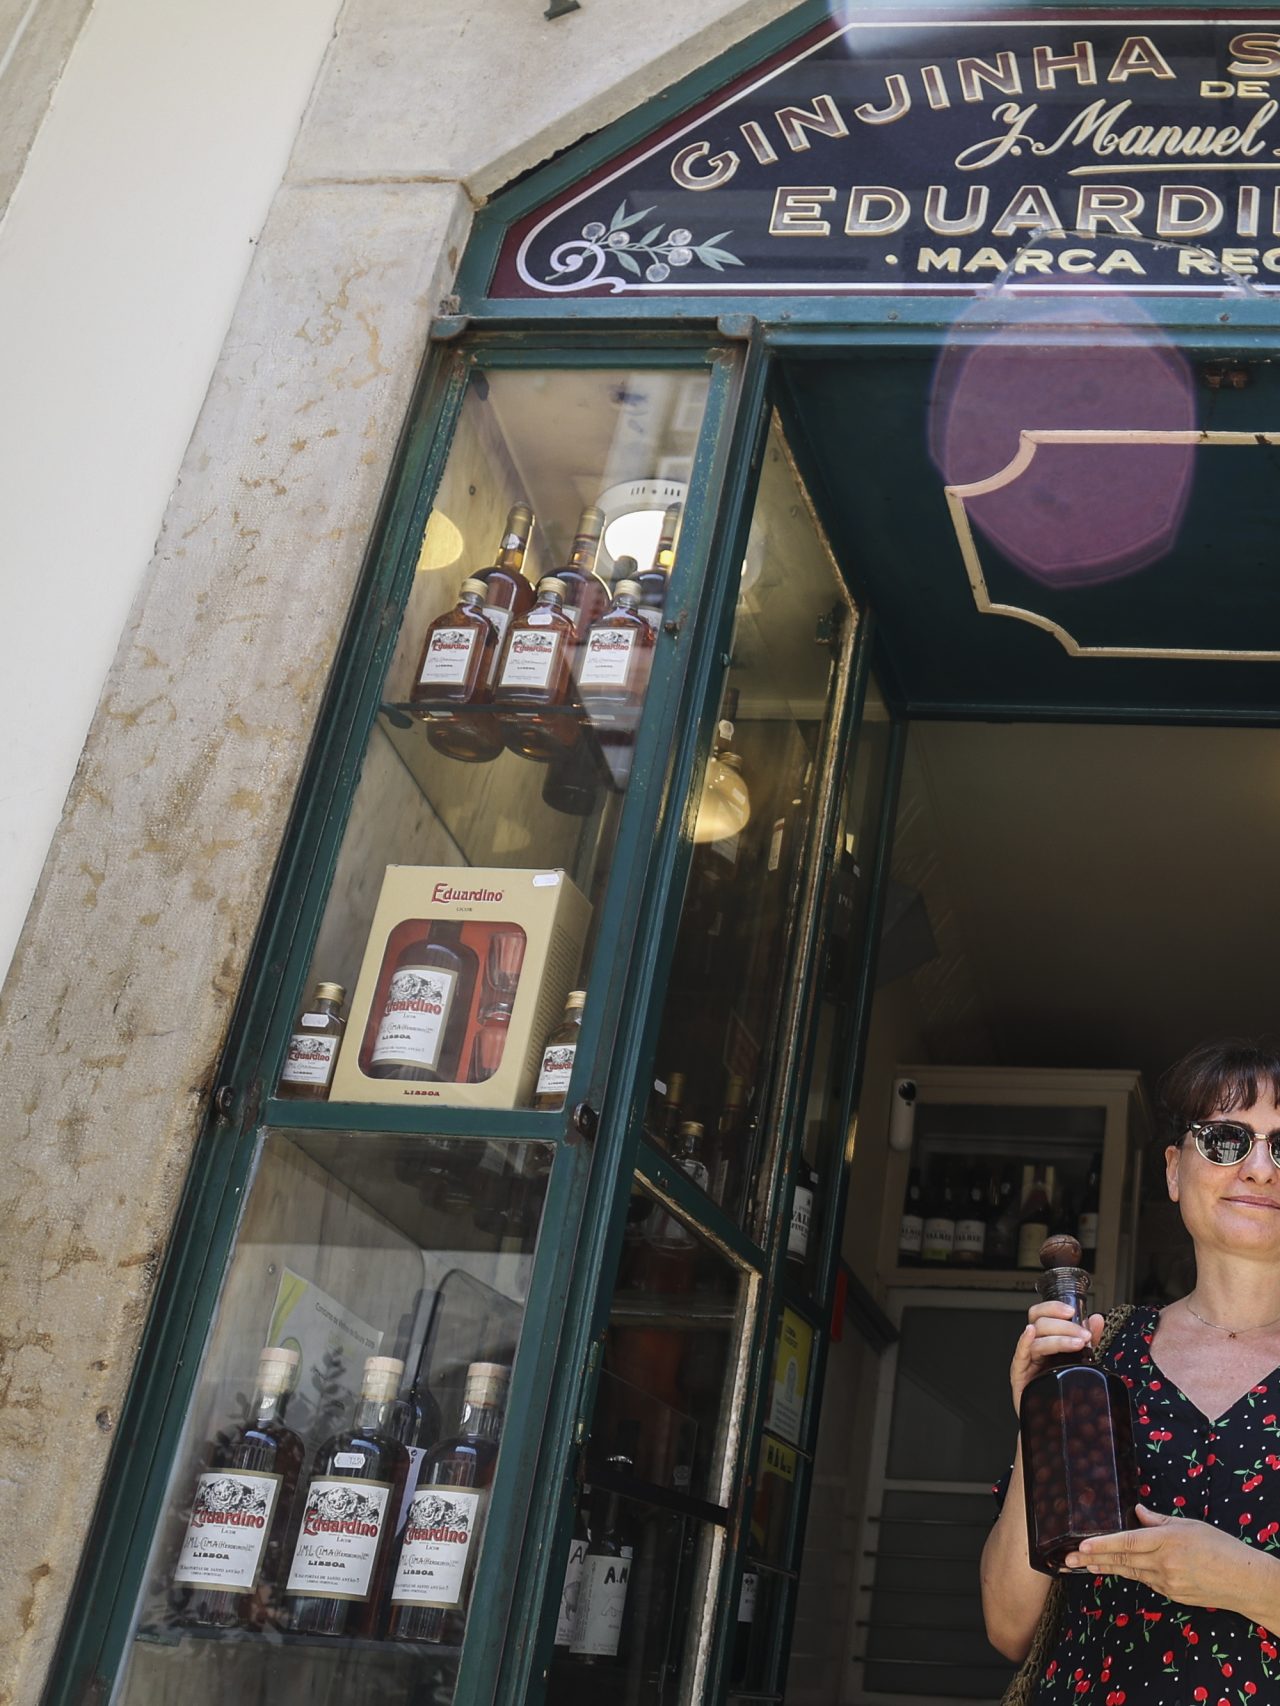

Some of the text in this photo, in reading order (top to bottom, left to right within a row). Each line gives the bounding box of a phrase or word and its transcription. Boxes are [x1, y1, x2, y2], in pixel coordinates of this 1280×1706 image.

[1200, 81, 1270, 99] DE
[670, 35, 1177, 191] GINJINHA
[1033, 98, 1268, 158] Manuel
[916, 247, 1151, 276] MARCA
[431, 882, 504, 904] Eduardino
[190, 1502, 266, 1528] Eduardino
[303, 1508, 378, 1537] Eduardino
[193, 1552, 230, 1560] LISBOA
[308, 1560, 346, 1569] LISBOA
[403, 1568, 434, 1576] LISBOA
